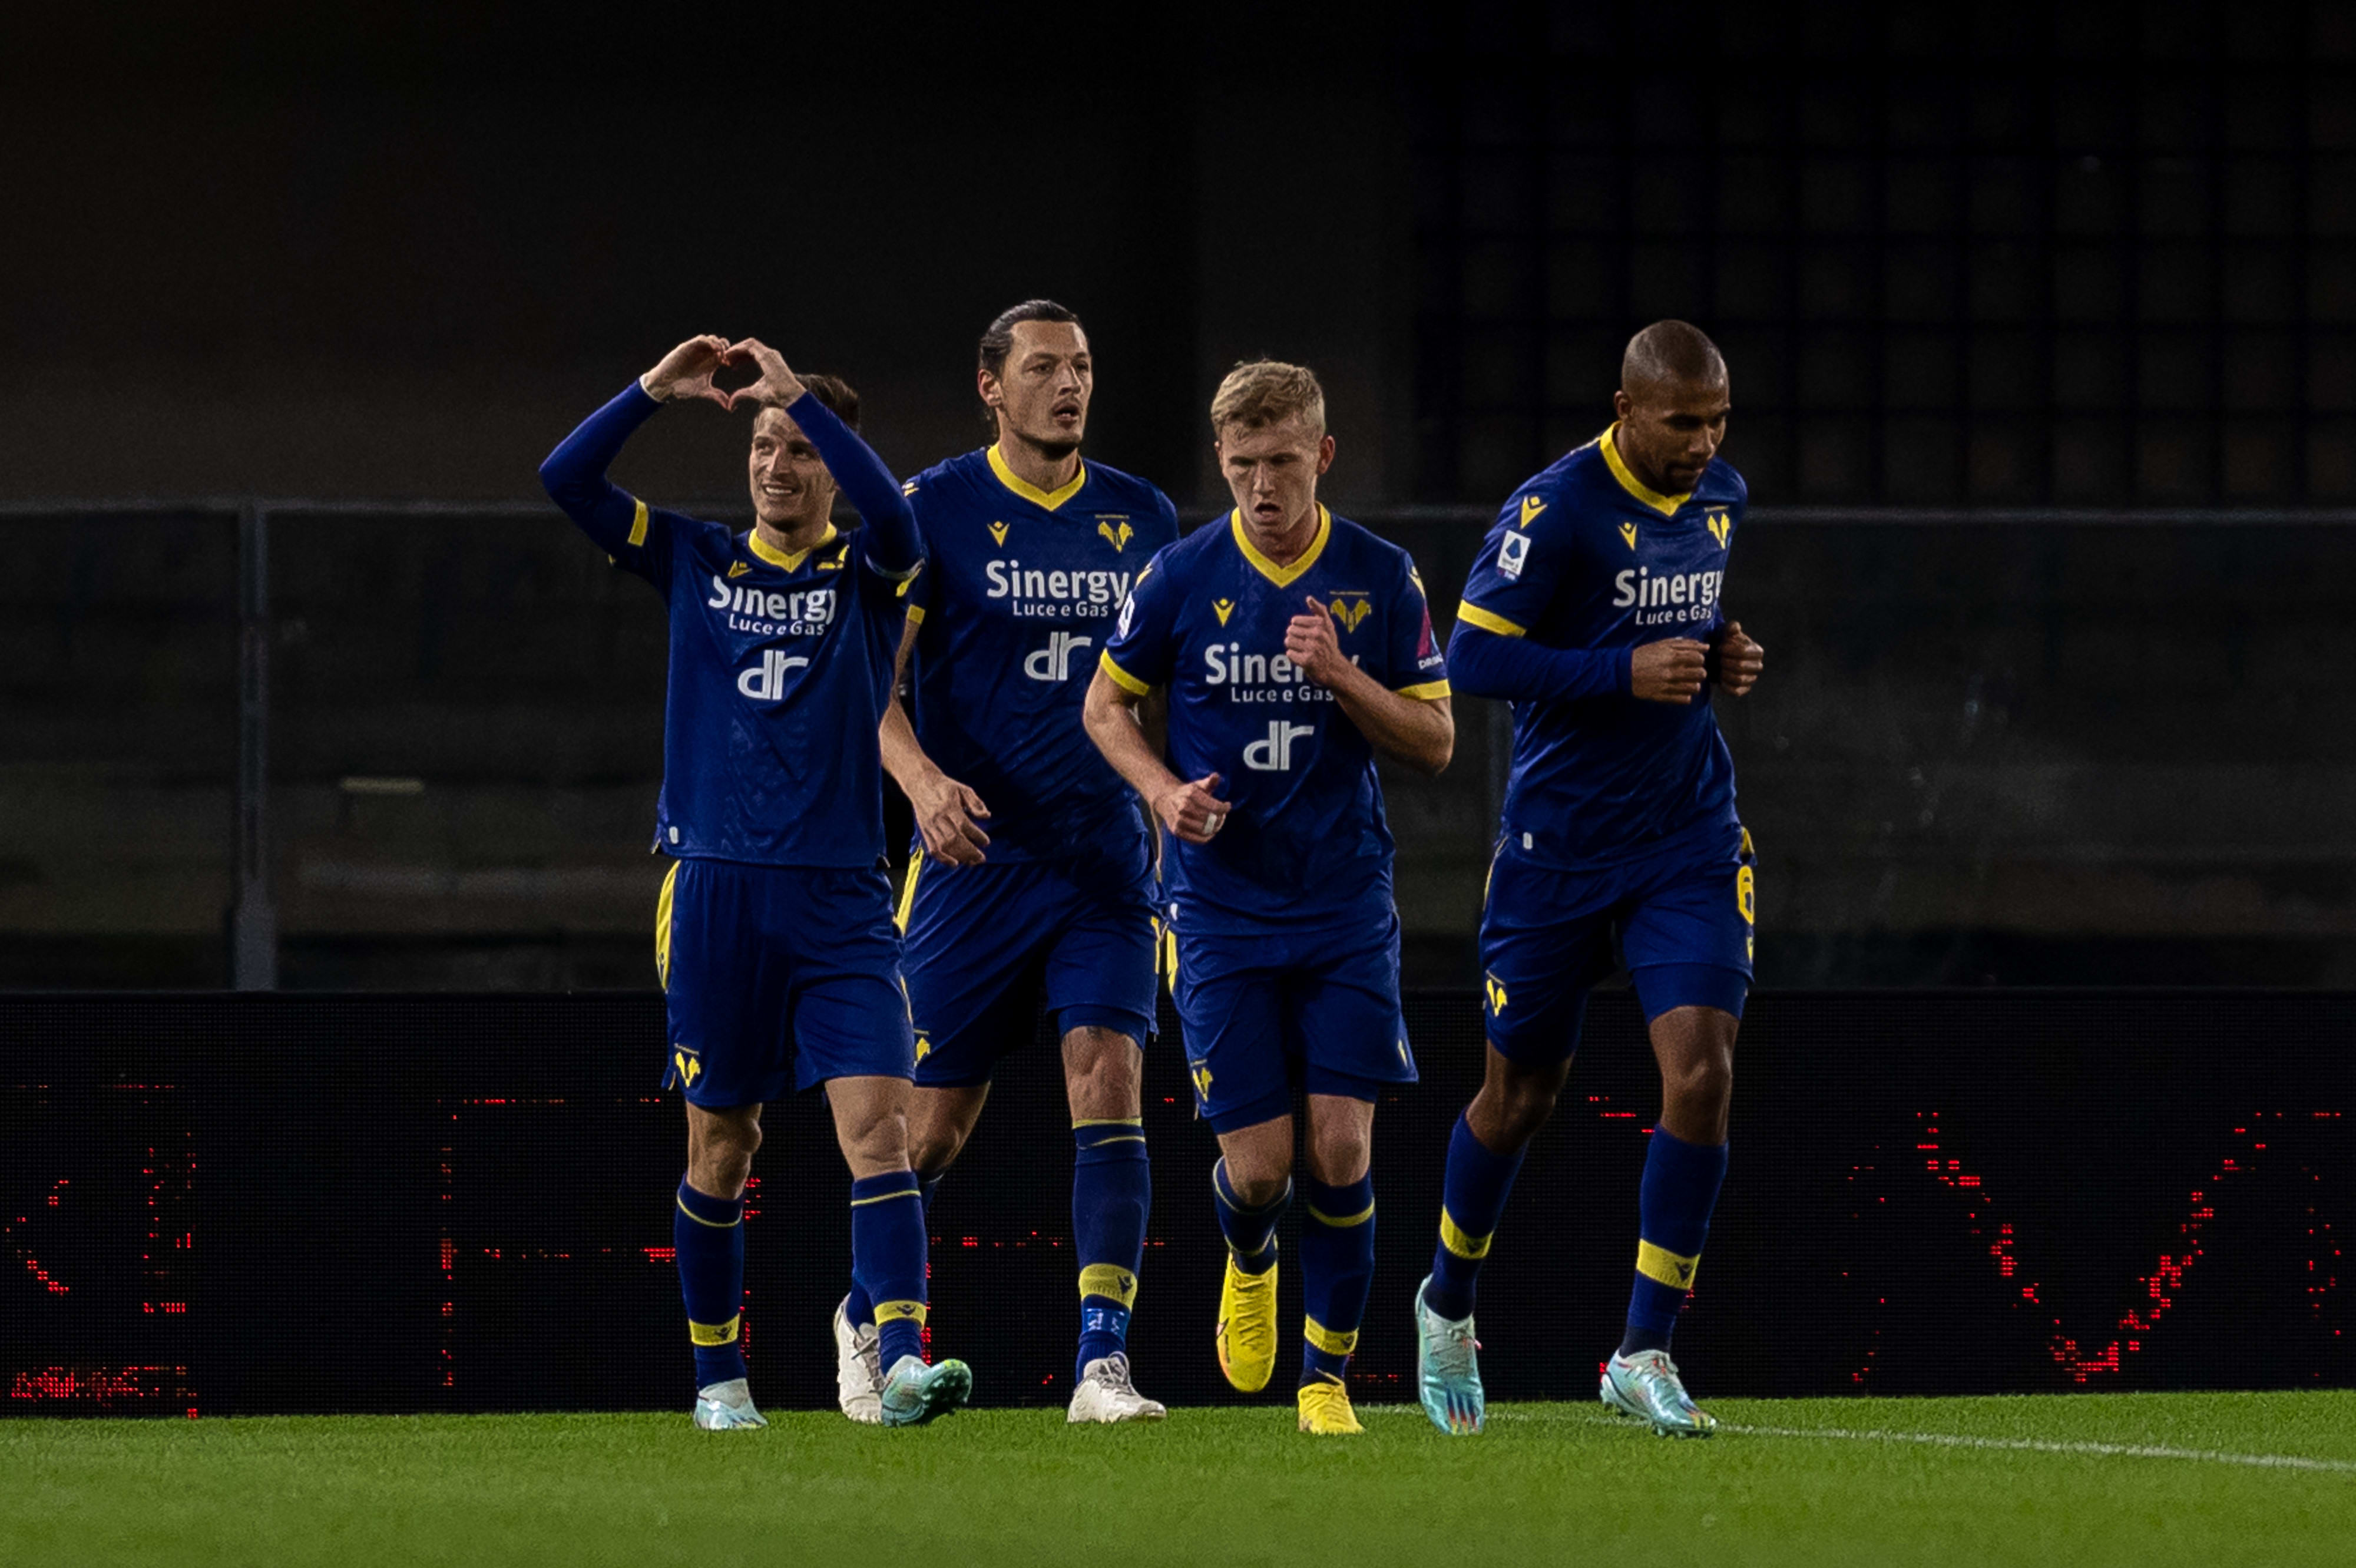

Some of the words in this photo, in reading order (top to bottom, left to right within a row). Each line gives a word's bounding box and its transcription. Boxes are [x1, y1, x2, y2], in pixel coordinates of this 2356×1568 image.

[986, 560, 1130, 610] Sinergy
[1012, 600, 1056, 616] Luce
[1060, 605, 1071, 616] e
[1076, 600, 1108, 617] Gas
[729, 613, 773, 635] Luce
[776, 624, 787, 636] e
[790, 620, 825, 636] Gas
[1636, 610, 1673, 626] Luce
[1677, 608, 1687, 622] e
[1690, 604, 1712, 620] Gas
[737, 649, 809, 700] dr
[1024, 631, 1093, 681] dr
[1231, 687, 1277, 702] Luce
[1282, 689, 1293, 702] e
[1298, 685, 1335, 702] Gas
[1243, 720, 1315, 770] dr
[1737, 865, 1754, 925] 6
